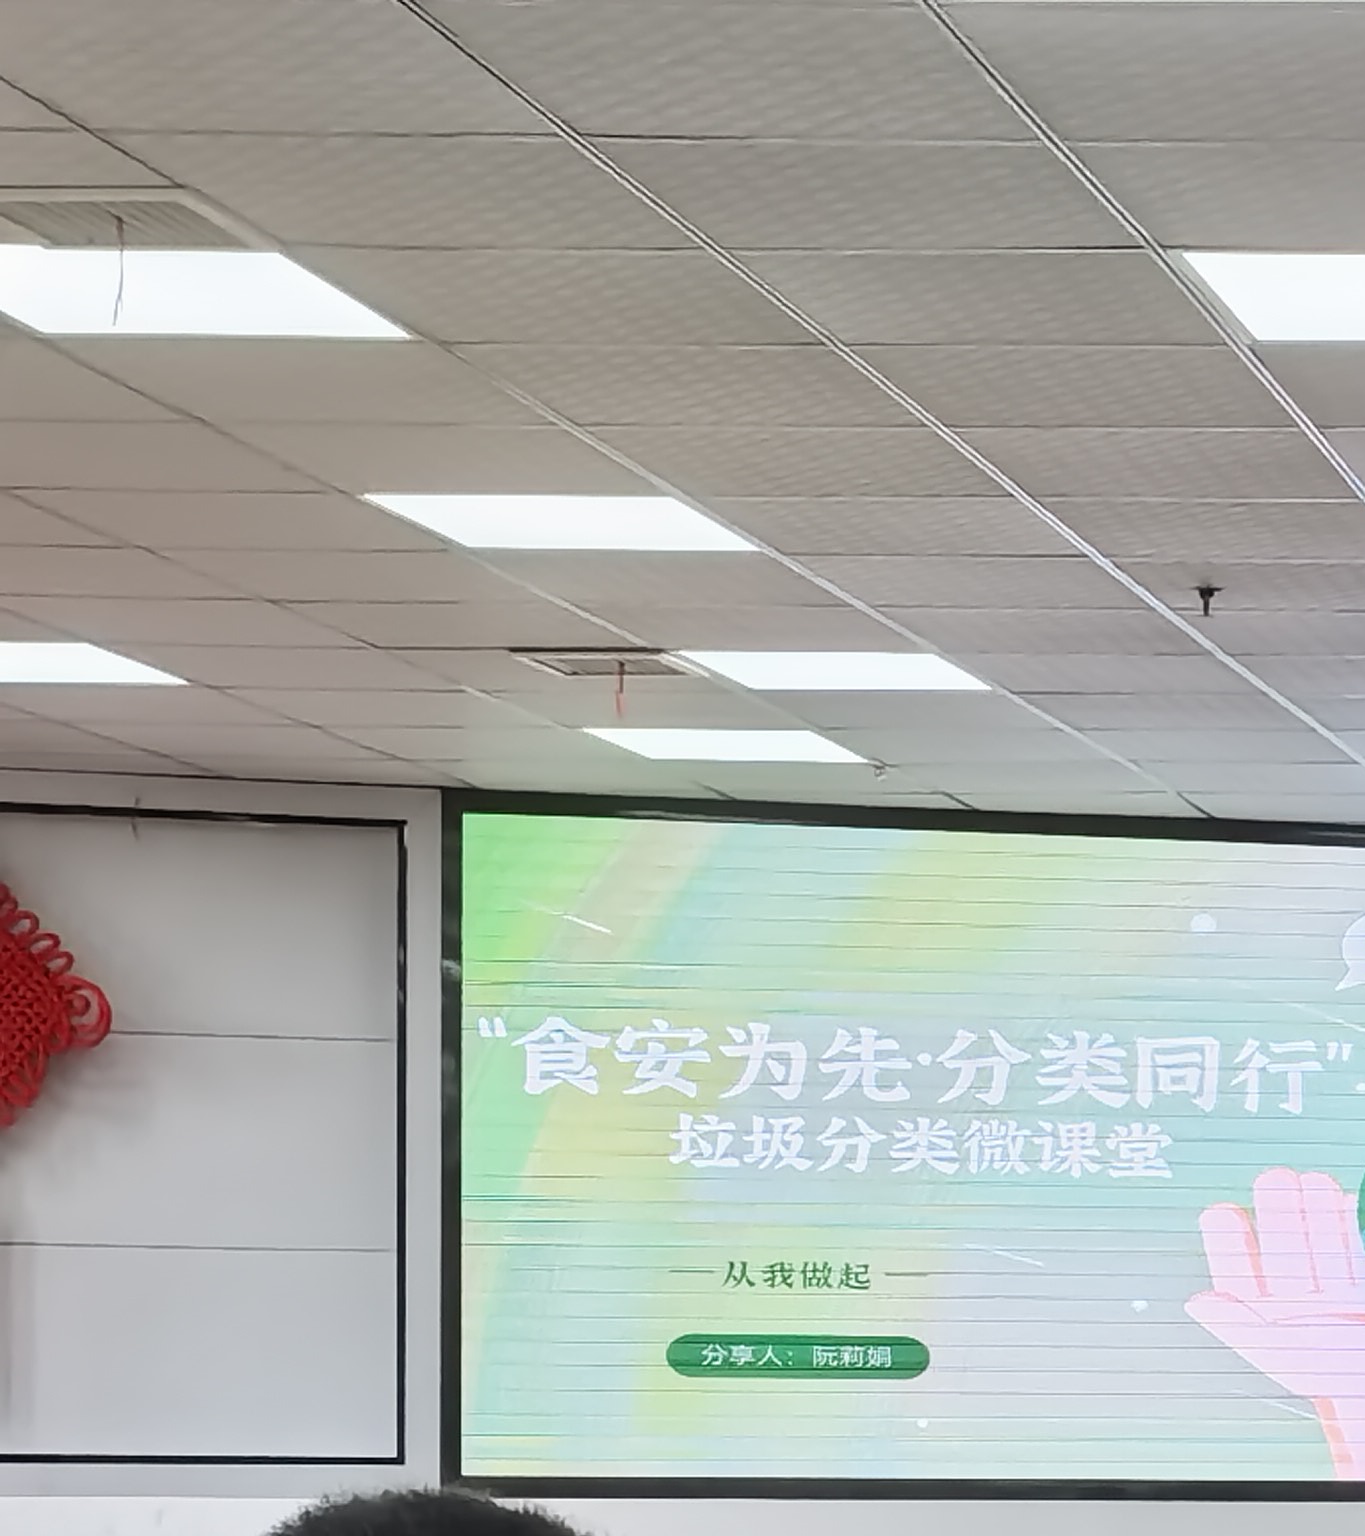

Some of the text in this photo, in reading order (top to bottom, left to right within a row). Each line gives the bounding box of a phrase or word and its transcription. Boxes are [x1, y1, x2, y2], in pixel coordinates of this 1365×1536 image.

[668, 1112, 1173, 1179] 垃圾分类微课堂
[721, 1260, 872, 1290] 从我做起
